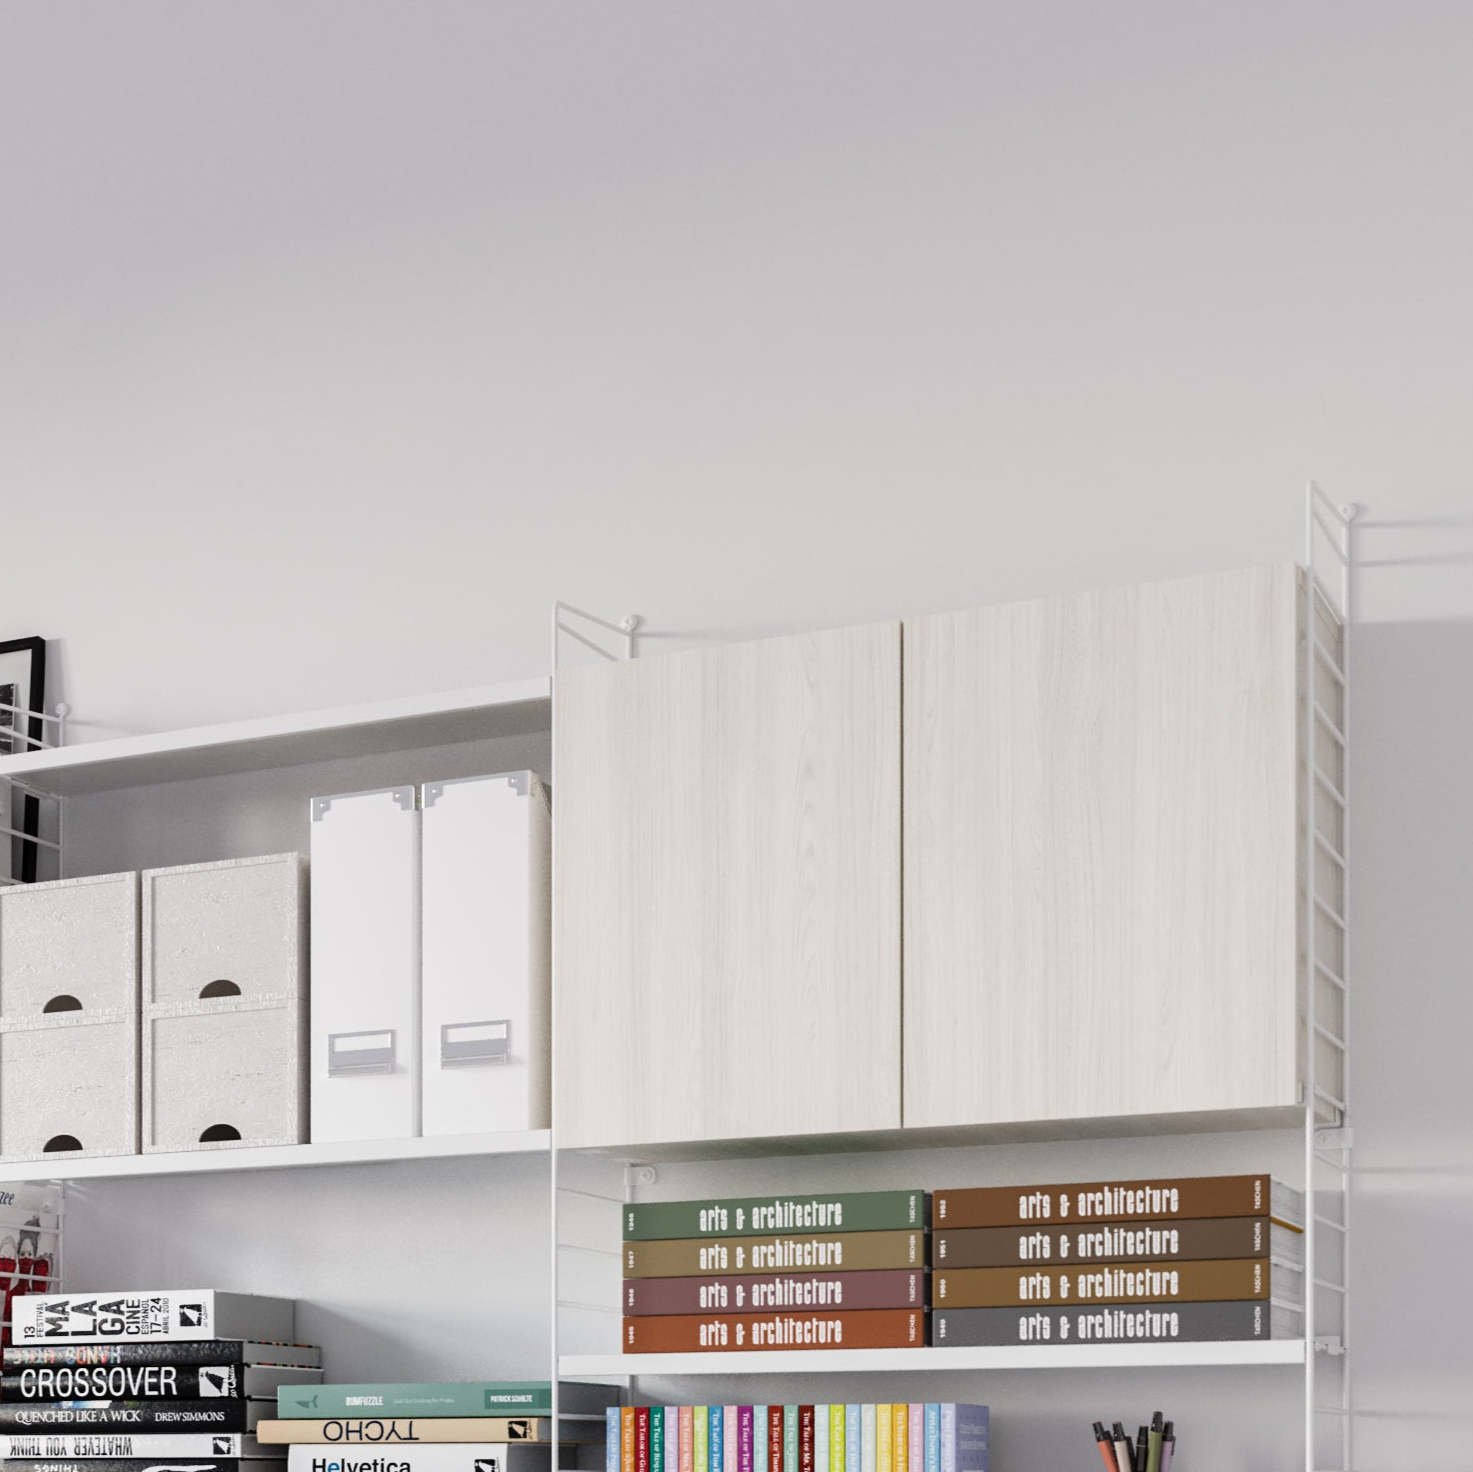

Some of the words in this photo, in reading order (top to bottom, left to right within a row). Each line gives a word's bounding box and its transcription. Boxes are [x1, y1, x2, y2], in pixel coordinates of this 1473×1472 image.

[1019, 1192, 1050, 1219] arts
[1060, 1194, 1070, 1217] &
[1078, 1186, 1179, 1216] architecture
[699, 1206, 728, 1232] arts
[736, 1208, 745, 1230] &
[752, 1201, 842, 1228] architecture
[36, 1302, 44, 1337] FESTIVAL
[71, 1300, 97, 1335] LA
[98, 1299, 125, 1335] GA
[126, 1299, 140, 1335] CINE
[24, 1326, 35, 1338] 13
[20, 1366, 177, 1397] CROSSOVER
[346, 1396, 383, 1406] BUMFUZZLE
[15, 1410, 74, 1424] QUENCHED
[76, 1410, 97, 1422] LIKE
[99, 1410, 108, 1422] A
[110, 1410, 141, 1422] WICK
[155, 1412, 180, 1422] DREW
[182, 1412, 225, 1422] SIMMONS
[323, 1420, 420, 1441] TYCHO
[10, 1438, 42, 1456] THINK
[46, 1438, 67, 1456] YOU
[74, 1437, 133, 1456] WHATEVER
[34, 1464, 78, 1472] THINGS
